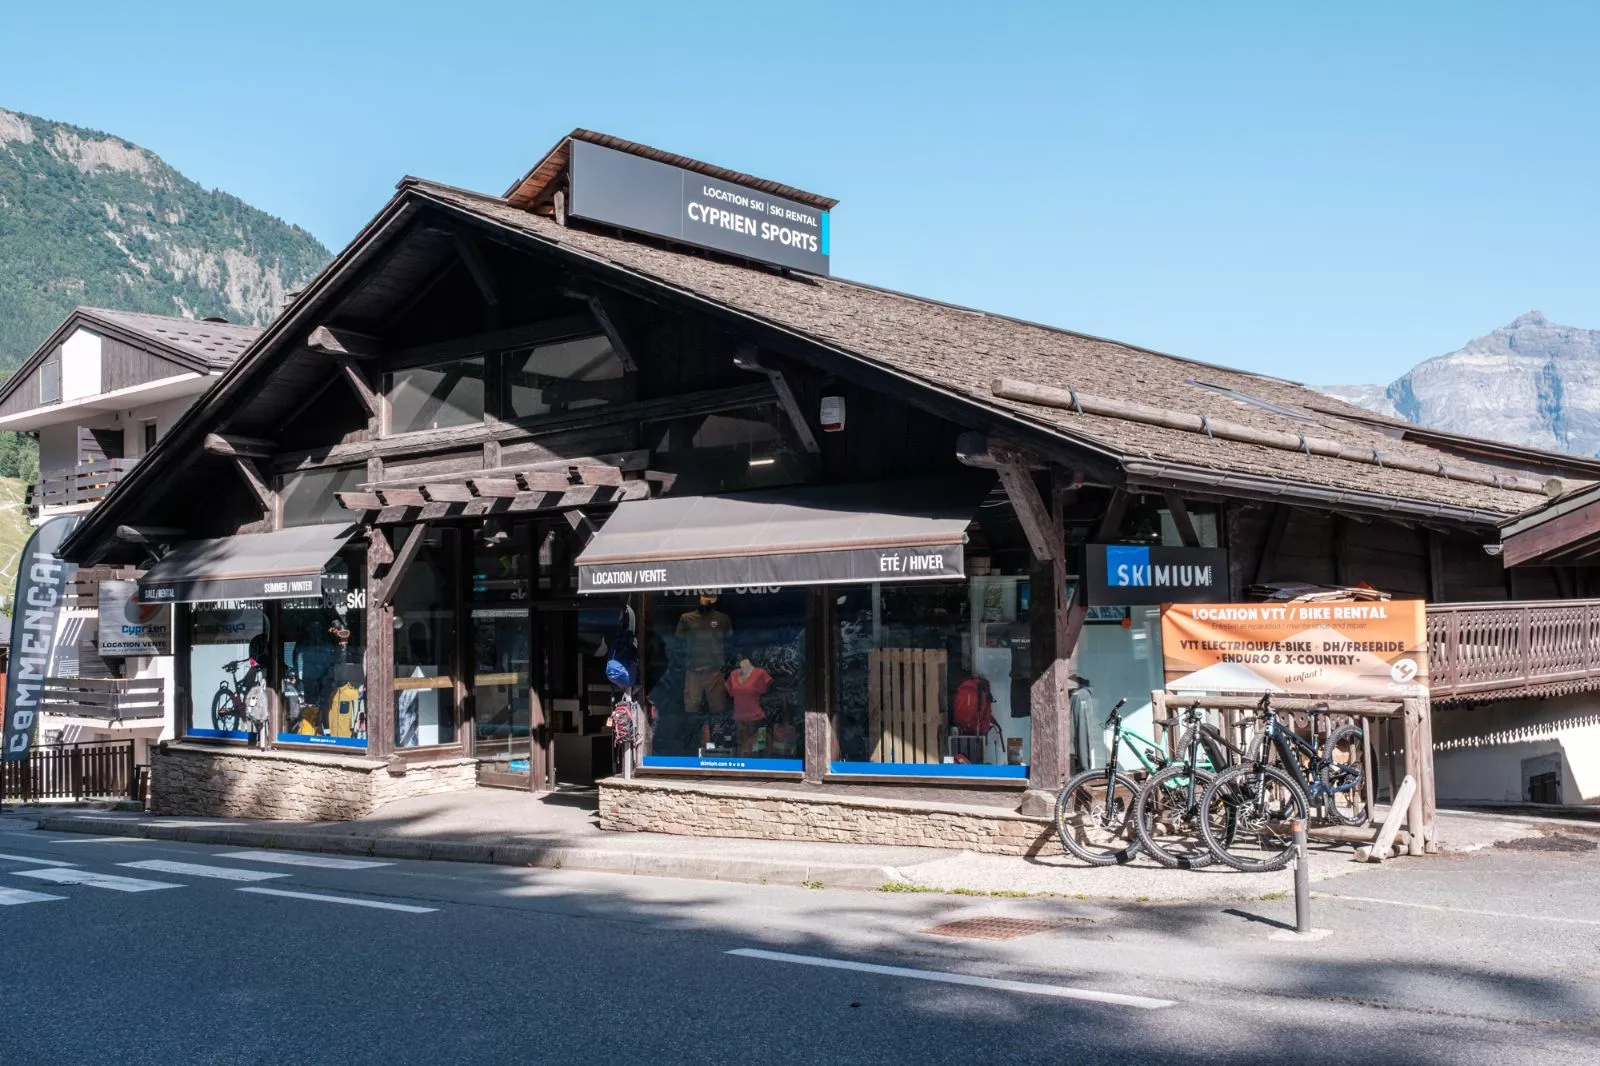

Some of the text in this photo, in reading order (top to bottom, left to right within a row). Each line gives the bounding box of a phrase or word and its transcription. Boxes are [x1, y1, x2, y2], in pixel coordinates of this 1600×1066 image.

[703, 186, 818, 227] LOCATION SKI SKI RENTAL
[687, 202, 818, 253] CYPRIEN SPORTS
[880, 552, 900, 572] ÉTÉ
[909, 554, 944, 570] HIVER
[592, 570, 633, 585] LOCATION
[640, 569, 667, 583] VENTE
[1117, 564, 1209, 587] SKIMIUM
[264, 582, 288, 593] SUMMER
[291, 580, 313, 591] WINTER
[346, 589, 366, 609] ski
[1192, 607, 1258, 621] LOCATION
[1260, 607, 1286, 620] VTT
[1299, 607, 1331, 620] BIKE
[1333, 606, 1387, 620] RENTAL
[121, 624, 167, 635] Cyprien
[1180, 640, 1405, 653] VTT ELECTRIQUE/E-BIKE DH/FREERIDE
[1221, 653, 1270, 664] ENDURO
[1285, 654, 1355, 665] X-COUNTRY
[1293, 670, 1318, 683] enfant
